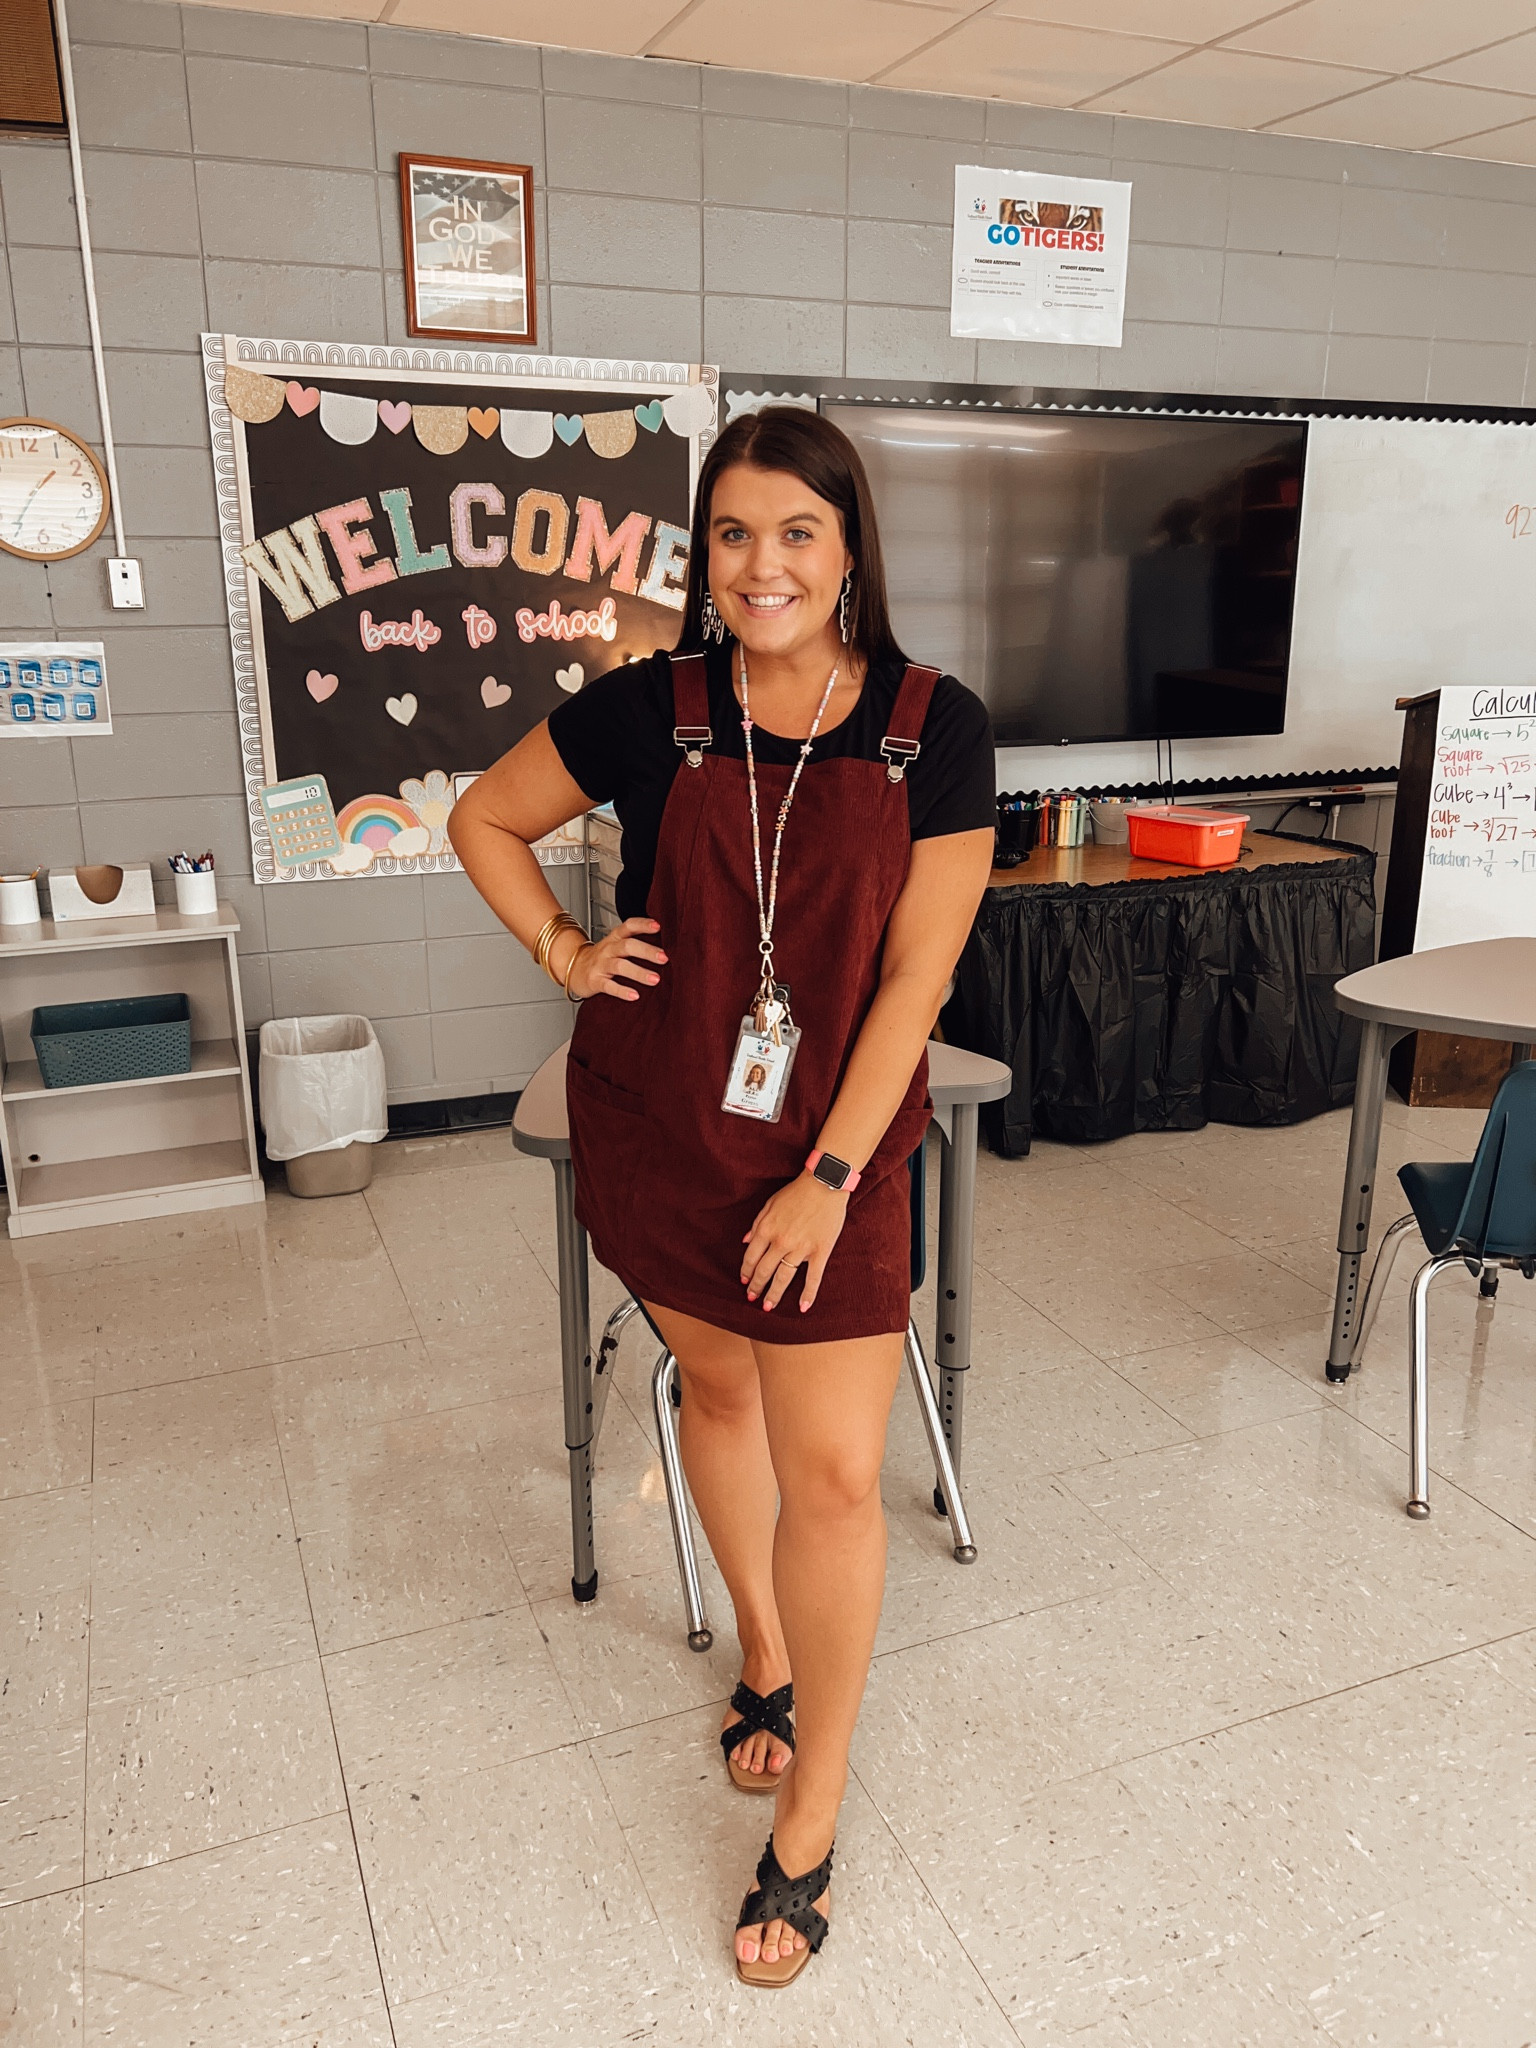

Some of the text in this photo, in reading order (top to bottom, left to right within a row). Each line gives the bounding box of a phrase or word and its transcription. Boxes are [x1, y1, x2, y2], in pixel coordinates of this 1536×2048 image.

[453, 195, 482, 221] IN
[429, 217, 495, 245] GOD
[447, 244, 493, 271] WE
[20, 436, 38, 453] 12
[69, 459, 82, 476] 2
[81, 482, 93, 498] 3
[75, 507, 88, 520] 4
[1505, 504, 1536, 539] 92
[37, 529, 50, 545] 6
[240, 482, 691, 623] WELCOME
[360, 597, 617, 652] back to school
[1441, 725, 1490, 744] Square
[1437, 746, 1483, 766] Square
[1443, 764, 1472, 778] root
[305, 787, 317, 798] 10
[1430, 825, 1457, 839] root
[1427, 845, 1471, 867] fraction
